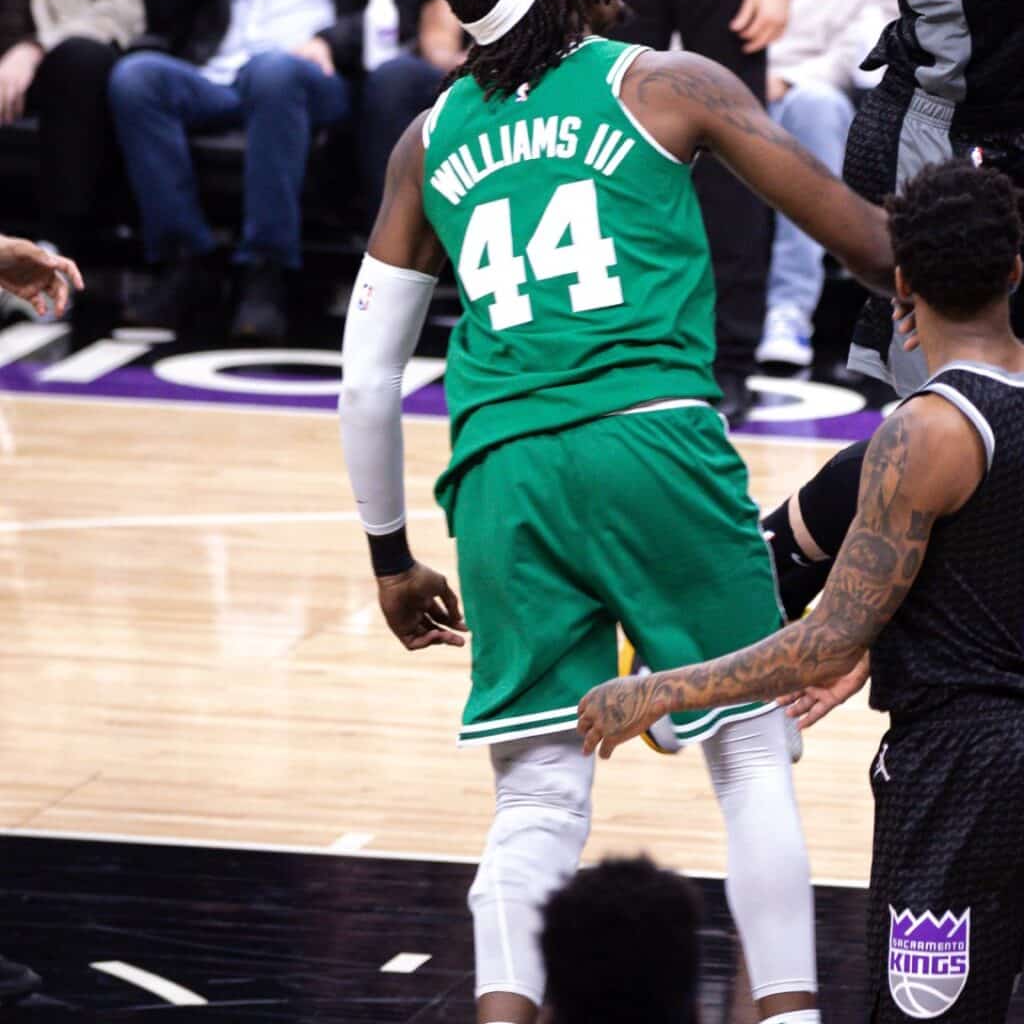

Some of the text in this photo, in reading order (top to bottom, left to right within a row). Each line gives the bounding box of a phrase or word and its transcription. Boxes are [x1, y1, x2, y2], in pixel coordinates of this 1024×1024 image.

[430, 115, 635, 205] WILLIAMS III
[457, 178, 624, 332] 44
[890, 951, 967, 975] KINGS
[892, 937, 965, 953] SACRAMENTO
